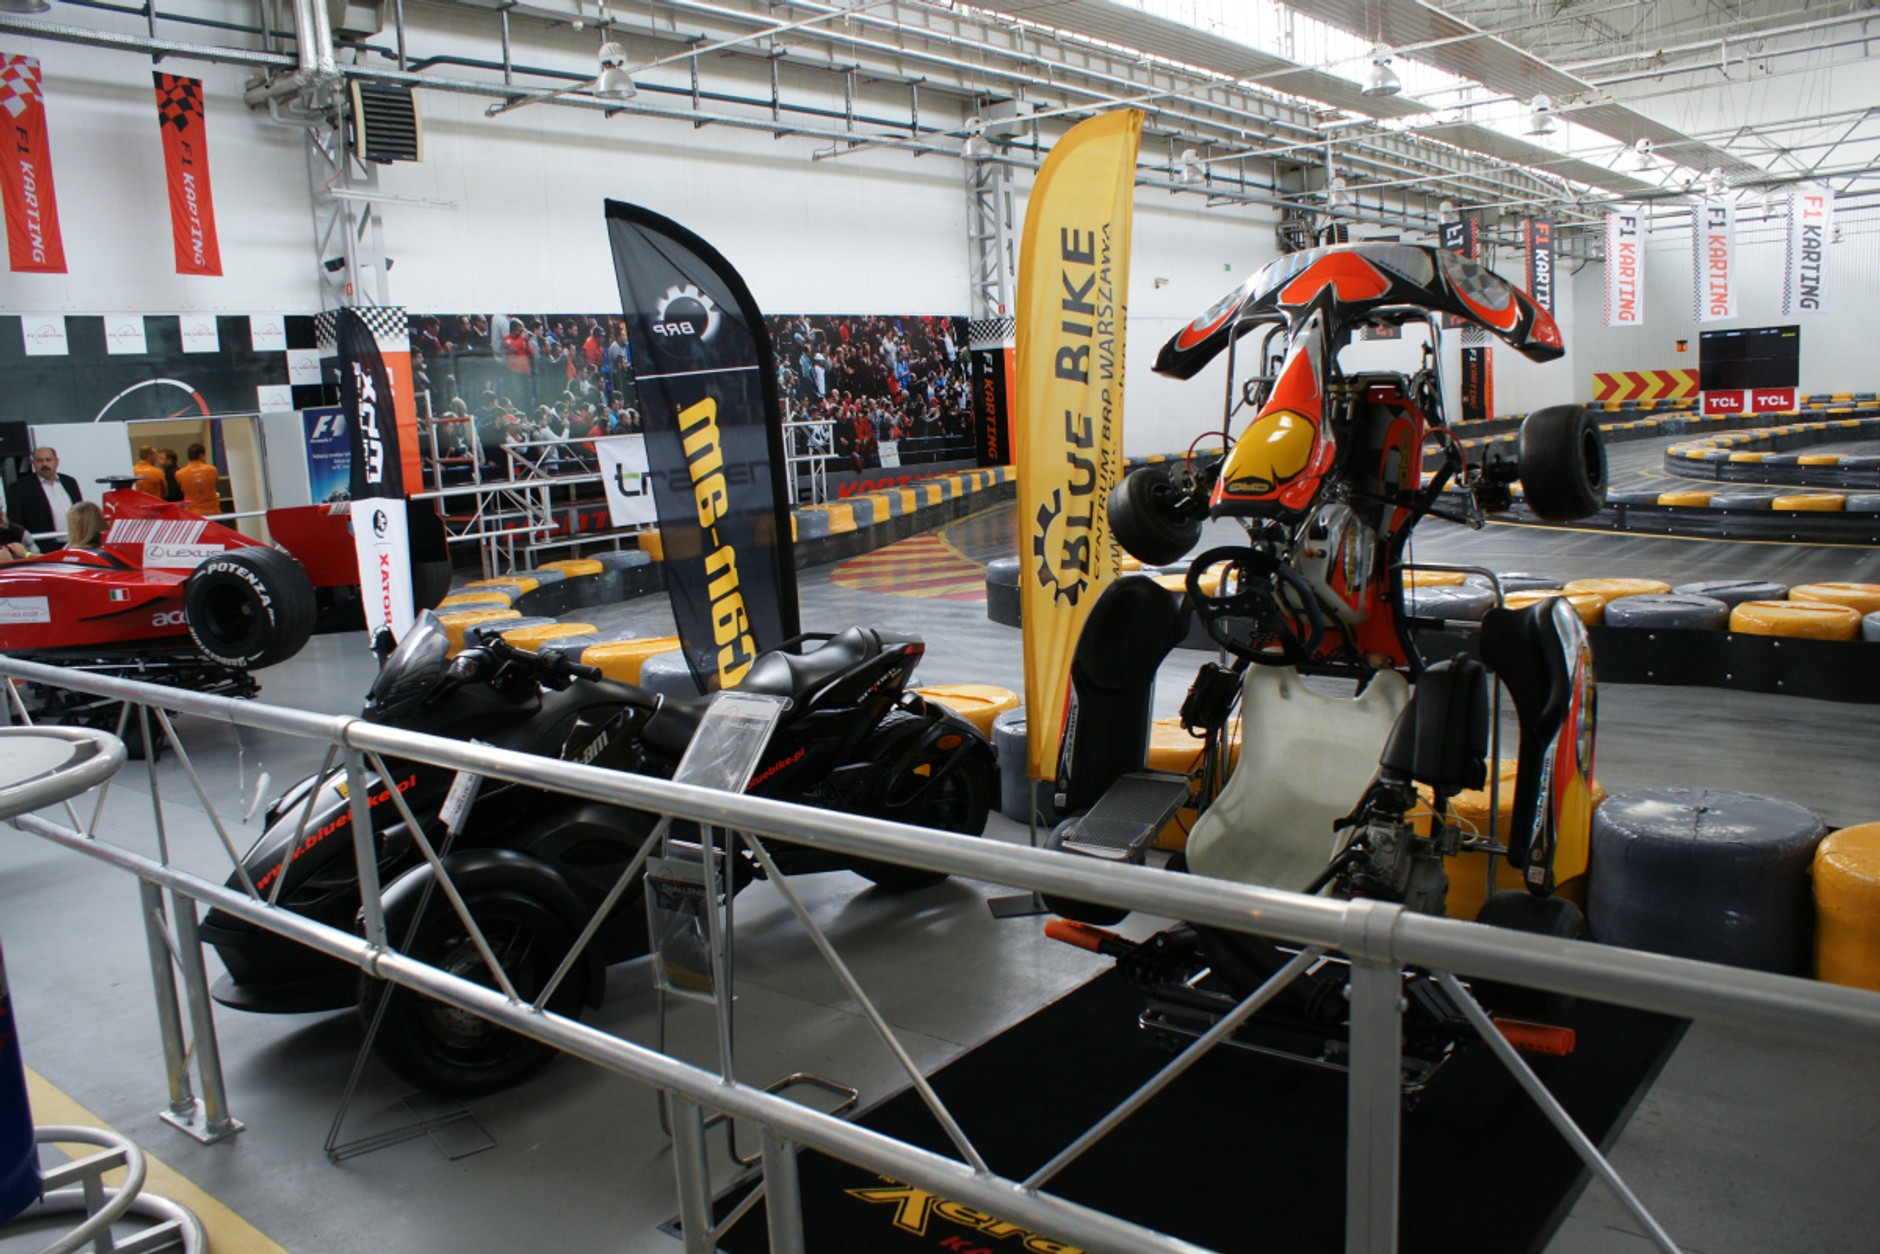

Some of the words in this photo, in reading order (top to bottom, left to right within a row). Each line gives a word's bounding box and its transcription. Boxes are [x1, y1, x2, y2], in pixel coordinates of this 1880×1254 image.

[16, 126, 30, 154] F1
[180, 140, 193, 165] F1
[20, 160, 46, 264] KARTING
[183, 172, 206, 268] KARTING
[1619, 216, 1636, 237] F1
[1708, 207, 1726, 229] F1
[1803, 195, 1823, 219] F1
[1535, 223, 1550, 244] F1
[1618, 243, 1636, 322] KARTING
[1708, 234, 1728, 317] KARTING
[1799, 224, 1823, 310] KARTING
[1055, 227, 1096, 386] BIKE
[982, 352, 993, 374] F1
[984, 378, 998, 460] KARTING
[1101, 389, 1113, 442] BRP
[1709, 397, 1739, 408] TCL
[1757, 395, 1789, 406] TCL
[1060, 410, 1097, 576] BLUE
[1094, 448, 1111, 581] CENTRUM
[167, 548, 222, 558] LEXUS
[207, 562, 272, 610] POTENZA
